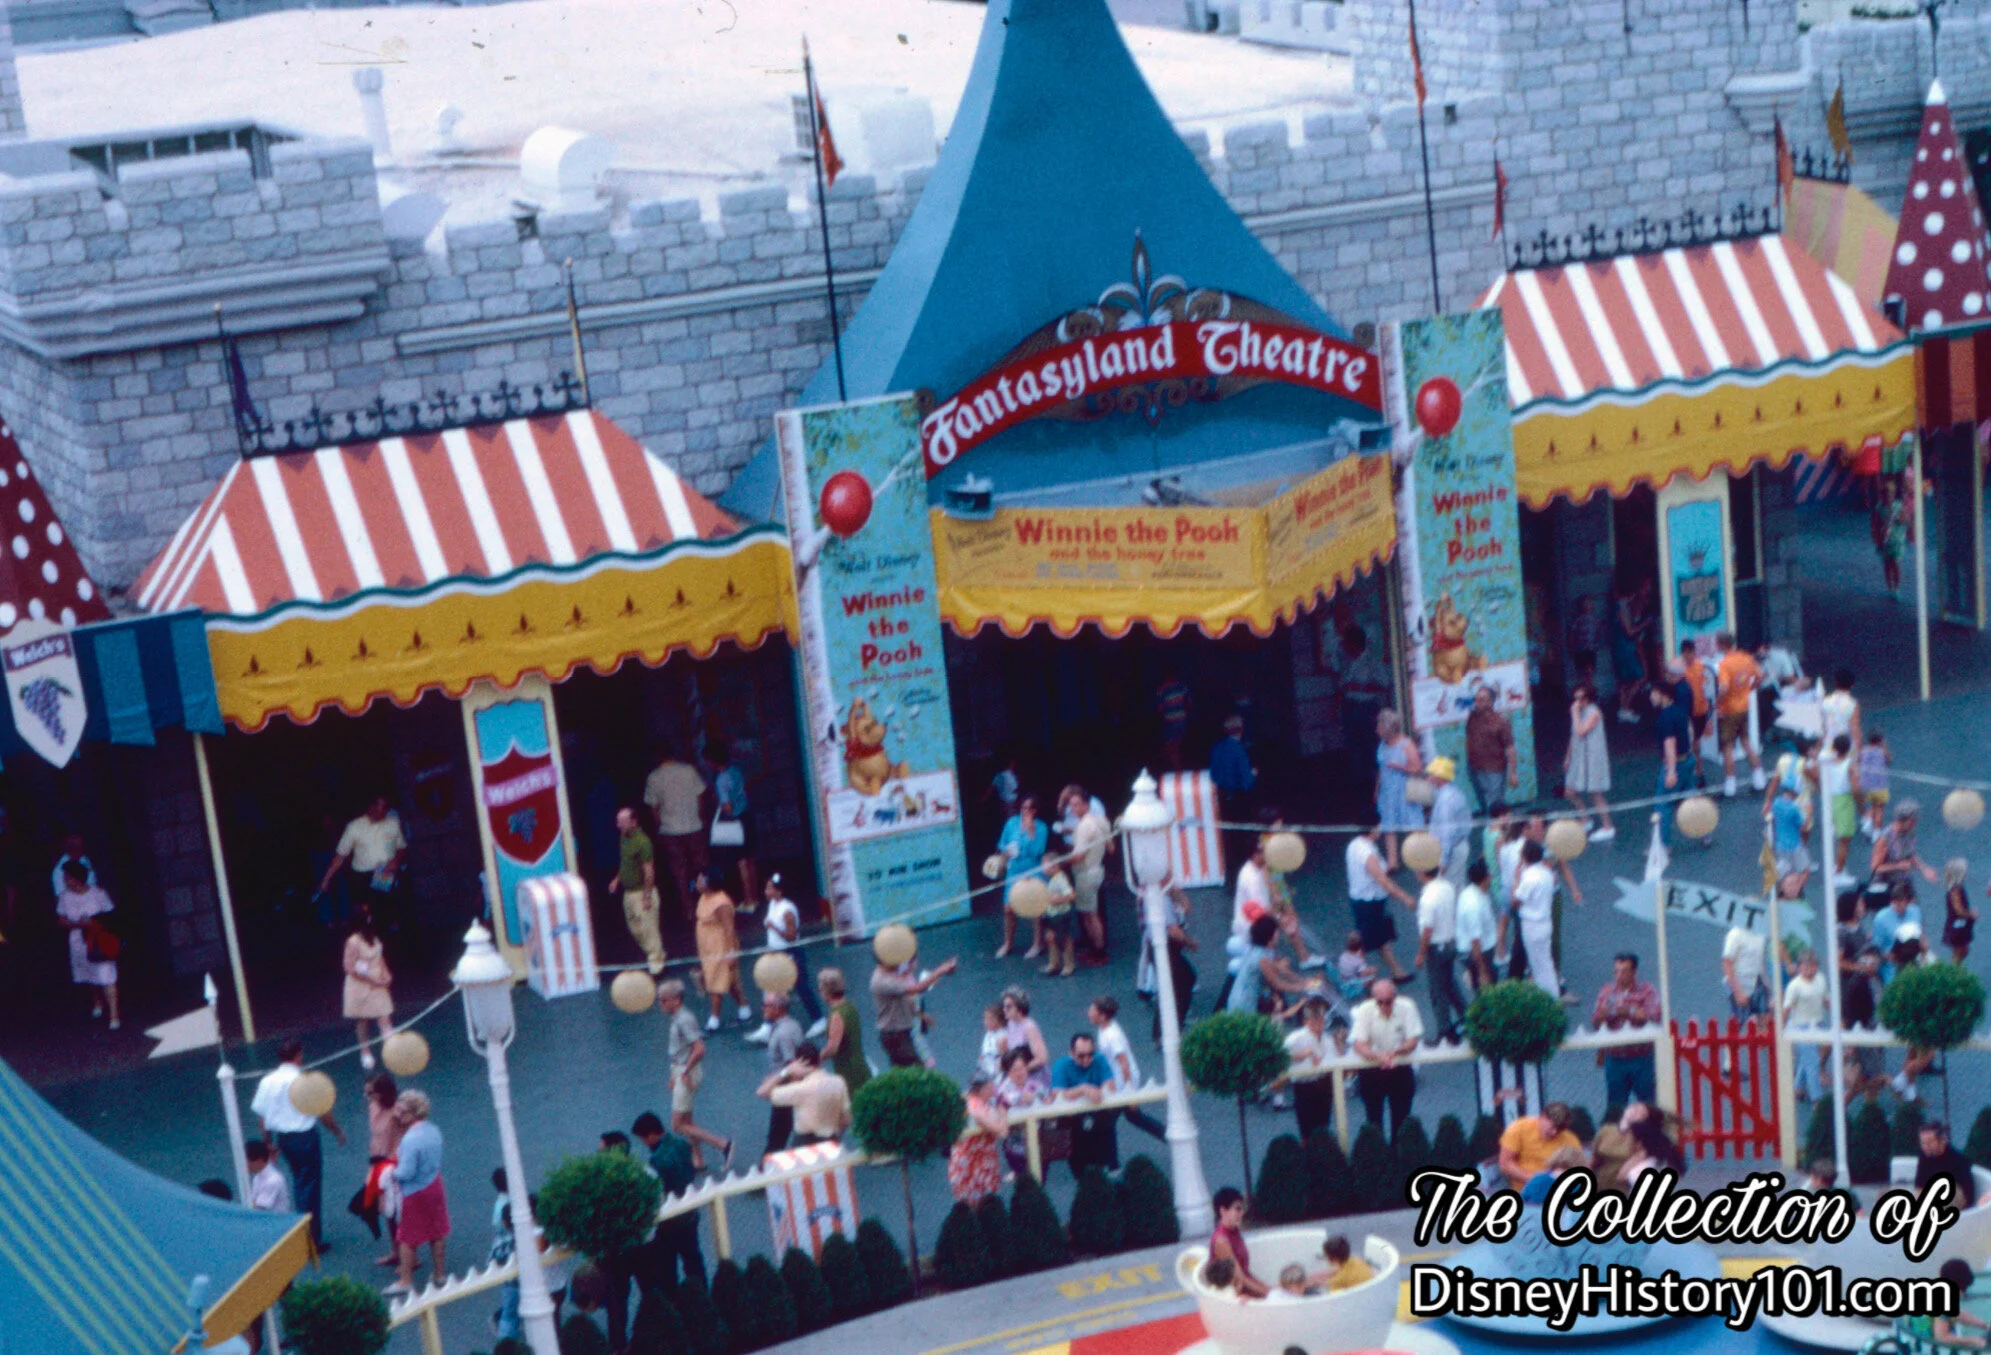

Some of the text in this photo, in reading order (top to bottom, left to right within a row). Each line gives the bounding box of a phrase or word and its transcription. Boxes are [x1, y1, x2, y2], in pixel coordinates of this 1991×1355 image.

[922, 321, 1368, 466] Fantasyland Theatre
[1432, 483, 1508, 516] Winnie
[1014, 516, 1118, 546] Winnie
[1125, 518, 1169, 544] the
[1174, 514, 1240, 546] Pooh
[1454, 513, 1491, 536] the
[1049, 546, 1080, 561] and
[1086, 546, 1112, 561] the
[1116, 546, 1164, 564] honey
[1446, 536, 1503, 567] Pooh
[841, 584, 925, 617] Winnie
[867, 615, 909, 639] the
[860, 639, 923, 671] Pooh
[1666, 885, 1766, 930] EXIT
[1055, 1263, 1162, 1299] EXIT
